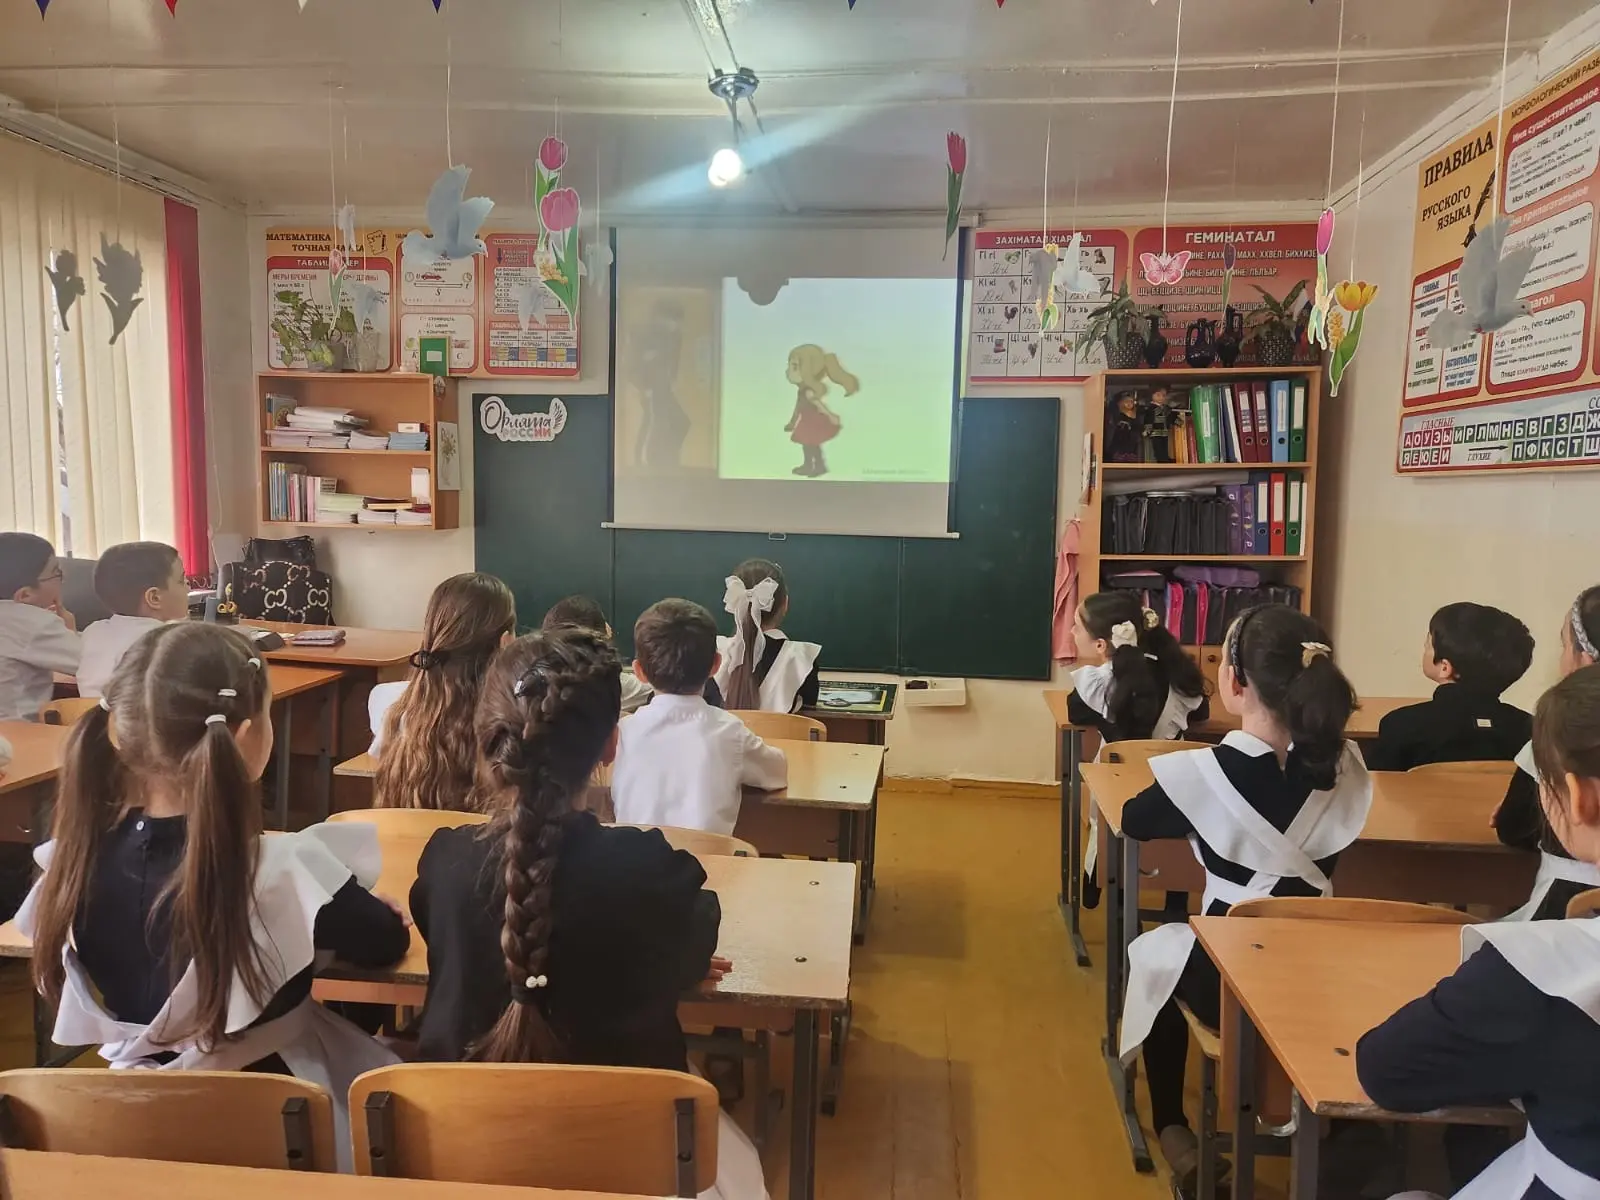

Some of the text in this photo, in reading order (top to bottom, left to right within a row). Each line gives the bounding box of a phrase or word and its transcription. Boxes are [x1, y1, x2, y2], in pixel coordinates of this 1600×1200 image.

[1510, 68, 1581, 119] МОРФОЛОГИЧЕСКИЙ
[1528, 87, 1599, 134] существительное
[1423, 131, 1494, 188] ПРАВИЛА
[1422, 185, 1471, 221] РУССКОГО
[1436, 204, 1471, 231] ЯЗЫКА
[265, 233, 332, 241] МАТЕМАТИКА
[291, 244, 331, 252] ТОЧНАЯ
[1185, 230, 1276, 244] ГЕМИНАТАЛ
[484, 400, 552, 433] Орлята
[1421, 417, 1456, 430] ГЛАСНЫЕ
[502, 428, 552, 439] РОССИИ
